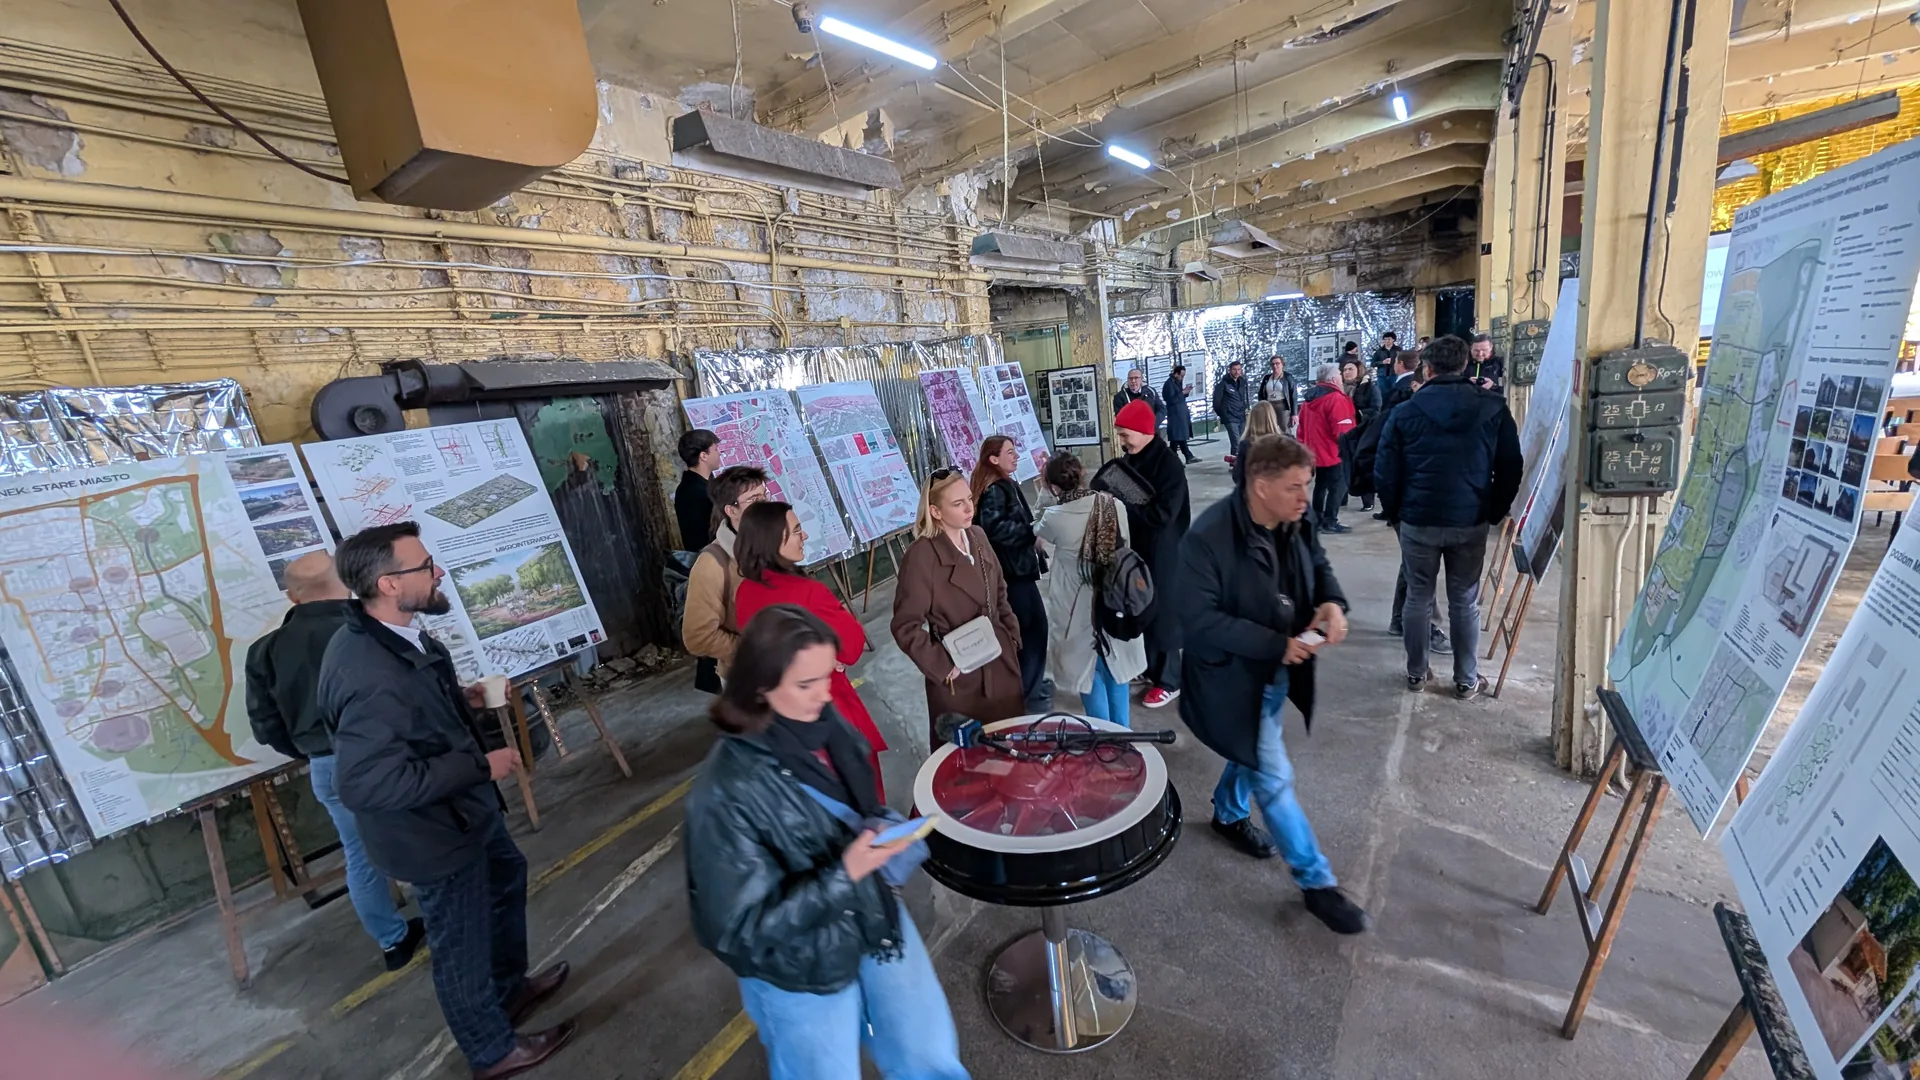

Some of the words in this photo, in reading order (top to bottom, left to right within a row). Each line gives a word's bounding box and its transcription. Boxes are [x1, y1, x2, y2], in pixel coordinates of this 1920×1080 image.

[1604, 404, 1620, 414] 25
[1654, 403, 1665, 412] 13
[1604, 451, 1621, 461] 25
[32, 480, 77, 493] STARE
[79, 473, 130, 486] MIASTO
[495, 532, 560, 553] MIKROINTERWENCJA
[1889, 548, 1914, 568] poziom
